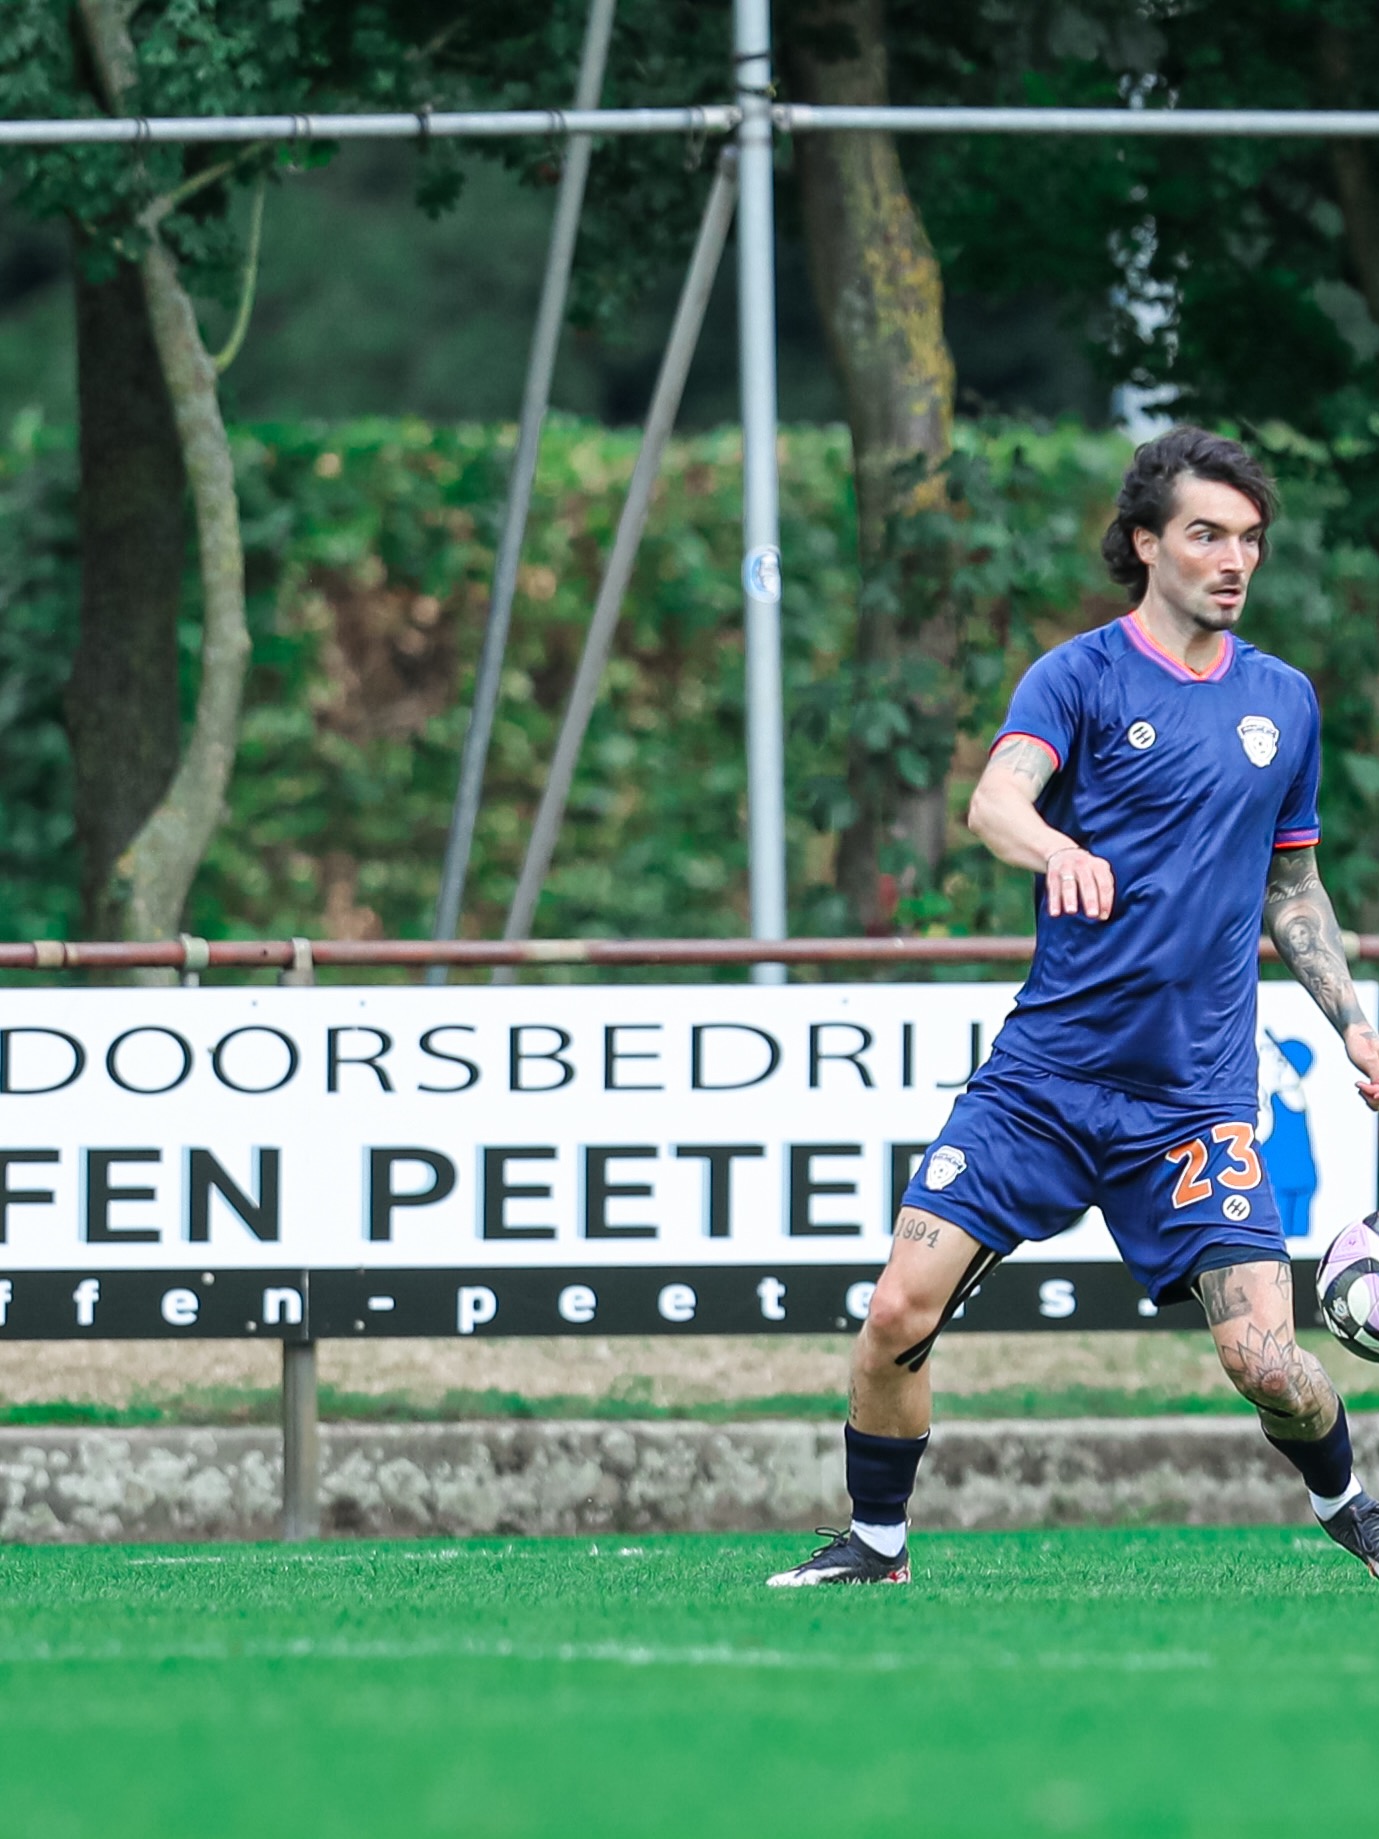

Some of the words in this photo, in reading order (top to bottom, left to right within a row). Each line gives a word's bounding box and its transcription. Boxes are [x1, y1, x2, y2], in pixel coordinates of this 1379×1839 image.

[0, 1022, 980, 1095] DOORSBEDRIJ
[0, 1145, 281, 1245] FEN
[1165, 1121, 1262, 1210] 23
[895, 1217, 941, 1249] 1994
